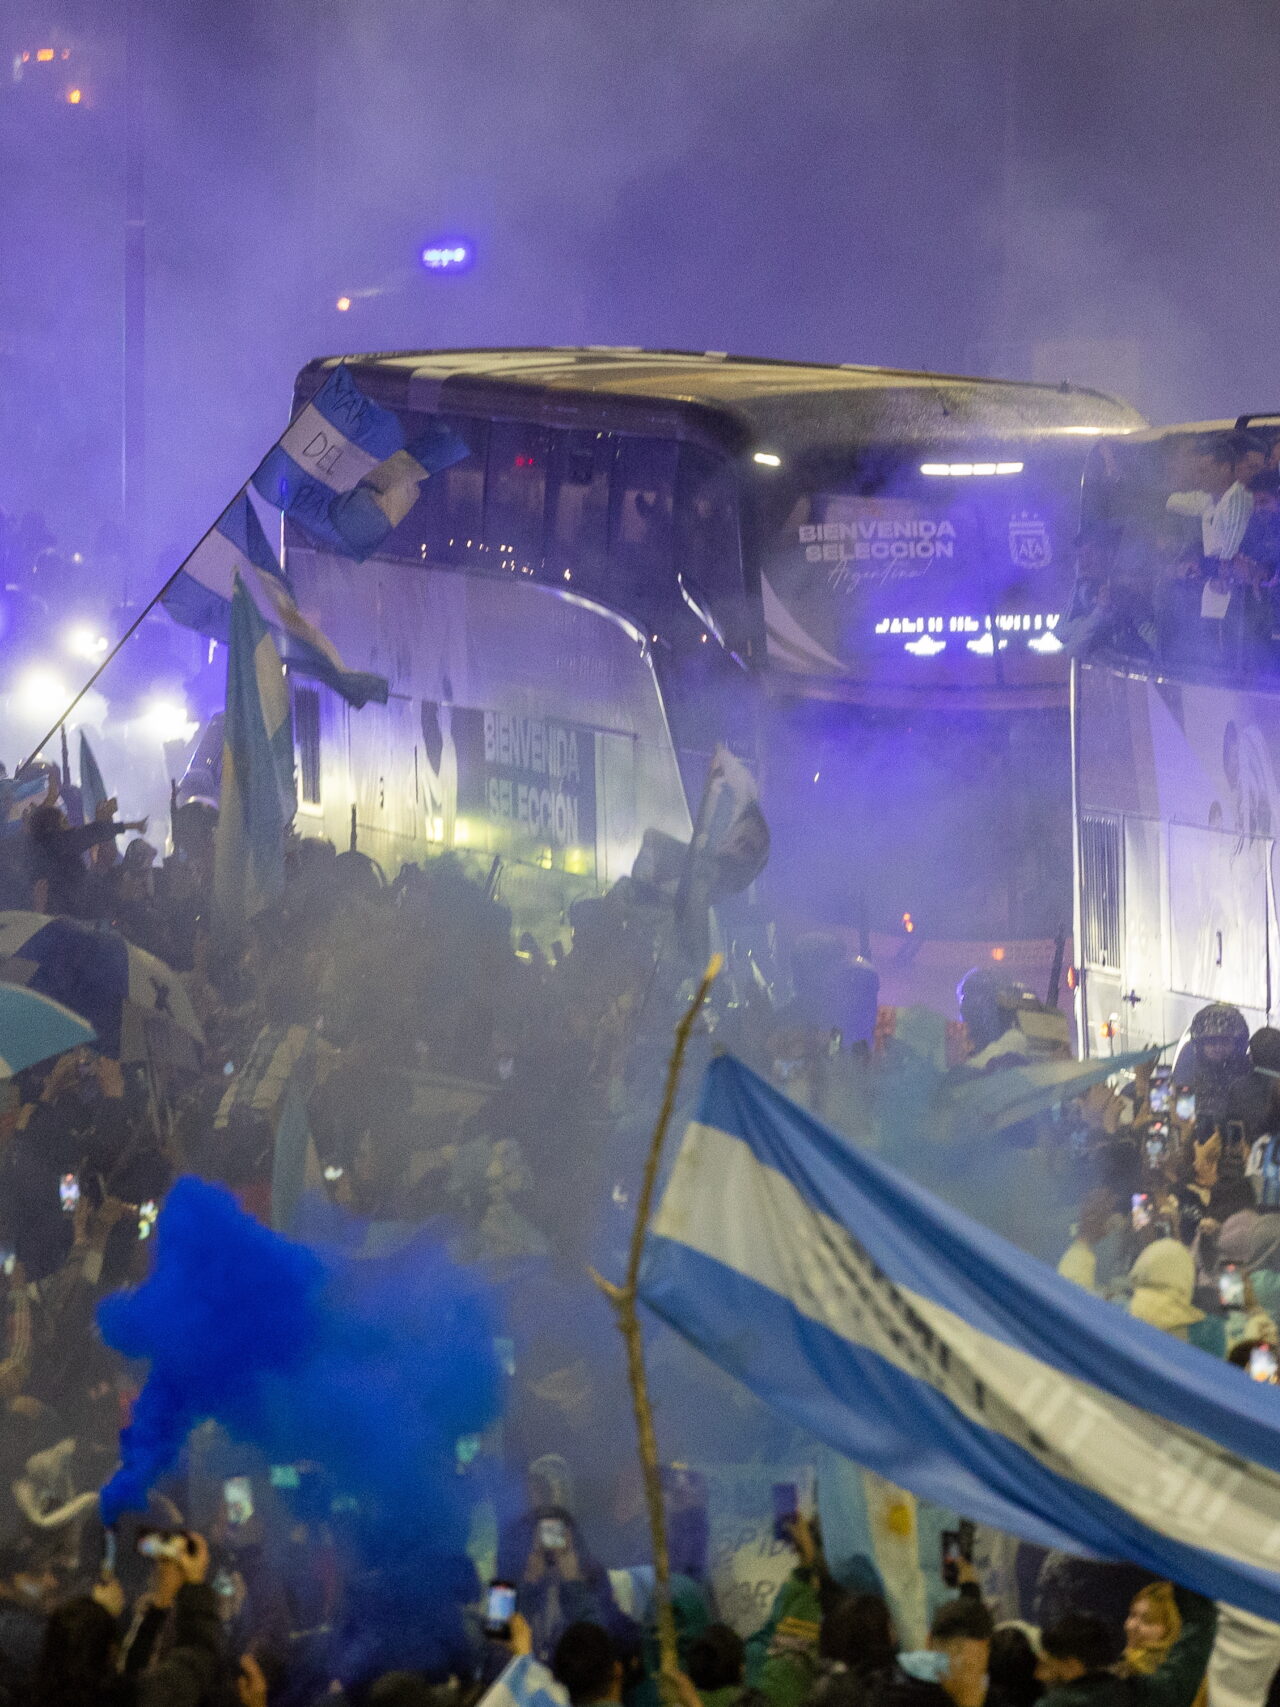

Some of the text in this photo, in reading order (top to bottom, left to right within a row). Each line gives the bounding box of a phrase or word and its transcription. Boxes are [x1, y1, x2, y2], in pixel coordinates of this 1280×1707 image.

[302, 430, 345, 476] DEL
[799, 520, 956, 542] BIENVENIDA
[805, 538, 954, 562] SELECCIÓN
